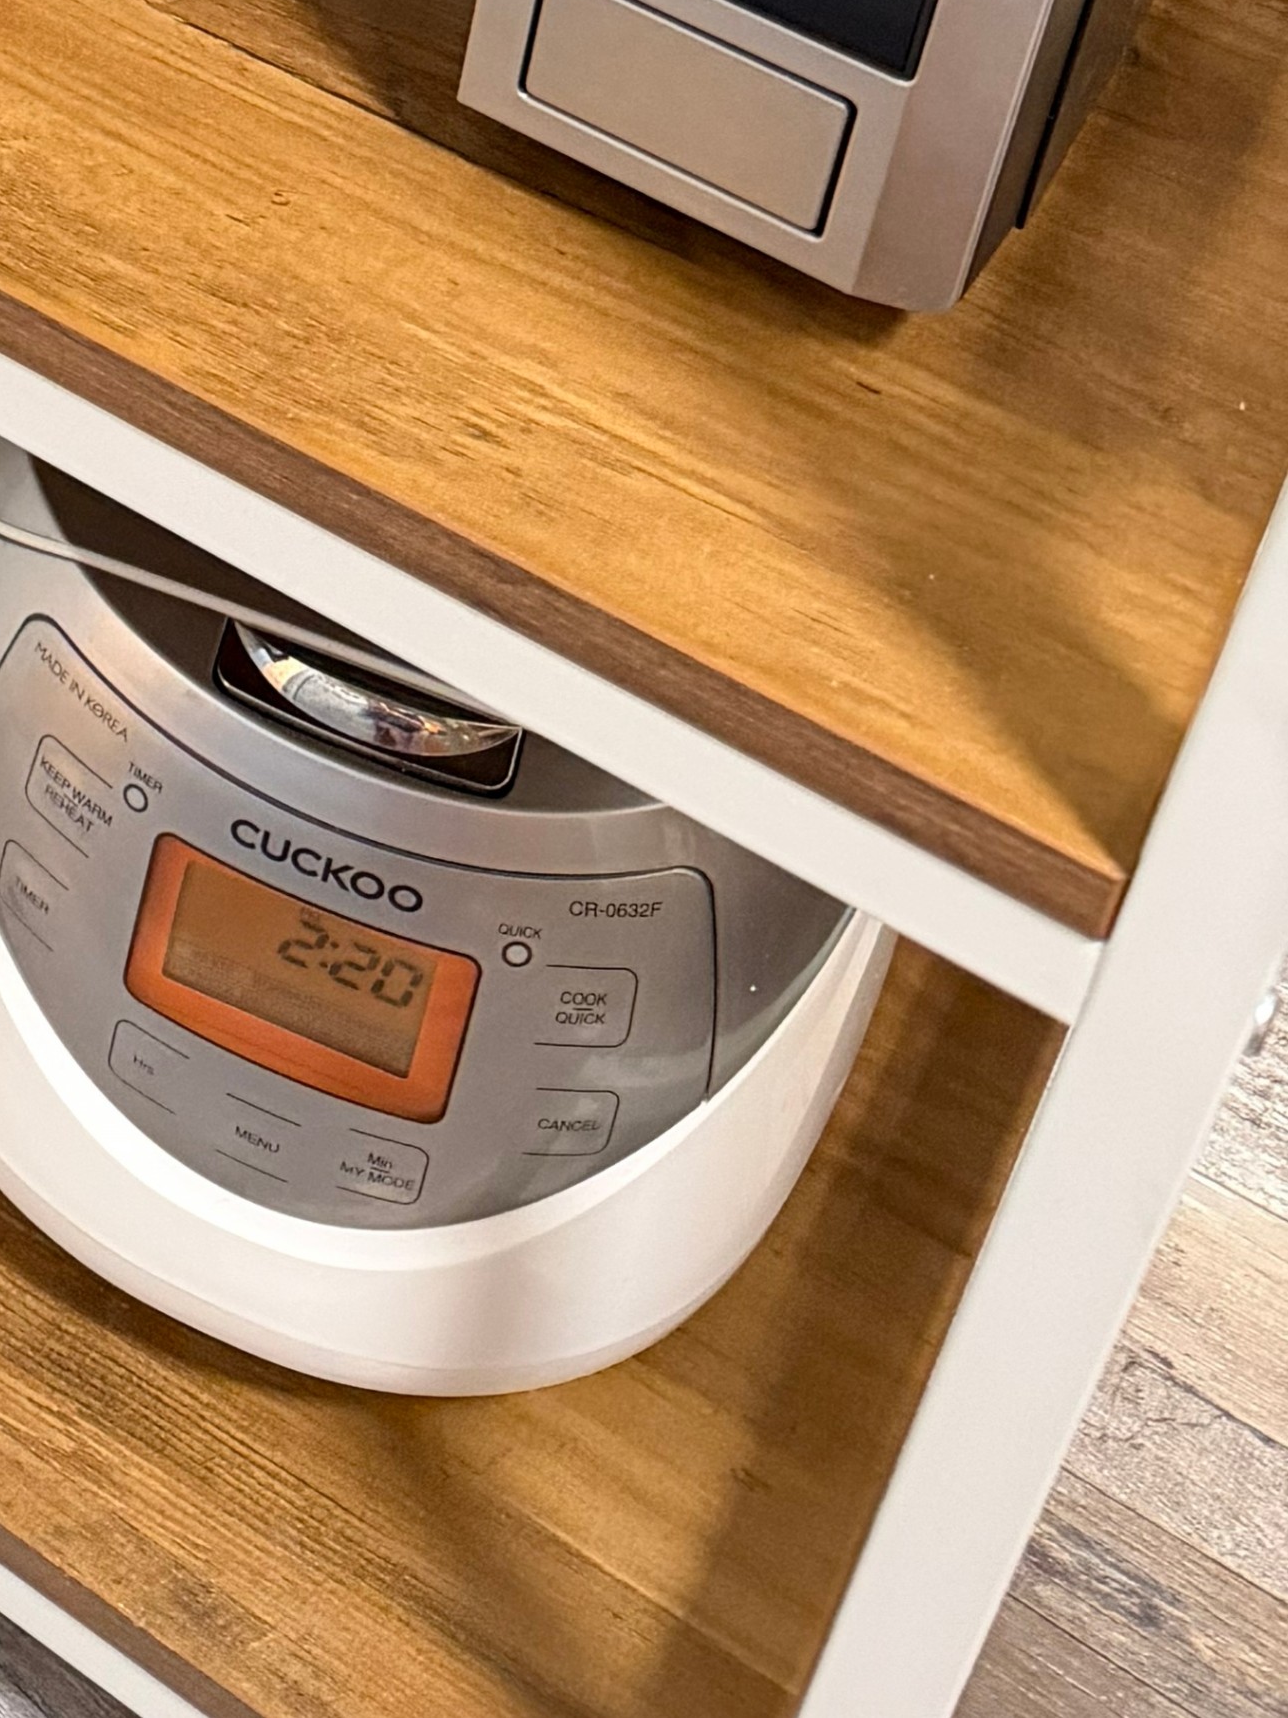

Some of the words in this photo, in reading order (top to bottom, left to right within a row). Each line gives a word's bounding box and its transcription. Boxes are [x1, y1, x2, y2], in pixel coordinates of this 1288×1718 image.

[35, 642, 67, 684] MADE
[69, 681, 85, 702] IN
[84, 696, 128, 742] KOREA
[40, 756, 71, 791] KEEP
[72, 786, 113, 827] WARM
[128, 761, 163, 794] TIMER
[45, 784, 94, 833] REHEAT
[230, 819, 423, 913] CUCKOO
[15, 876, 50, 914] TIMER
[569, 901, 663, 918] CR-0632F
[498, 923, 543, 940] QUICK
[277, 919, 423, 1009] 2:20
[559, 991, 608, 1006] COOK
[555, 1012, 606, 1026] QUICK
[132, 1054, 154, 1076] Hrs
[235, 1125, 280, 1154] MENU
[537, 1118, 601, 1132] CANCEL
[339, 1160, 365, 1177] MY
[367, 1170, 415, 1191] MODE
[367, 1152, 393, 1170] Min
